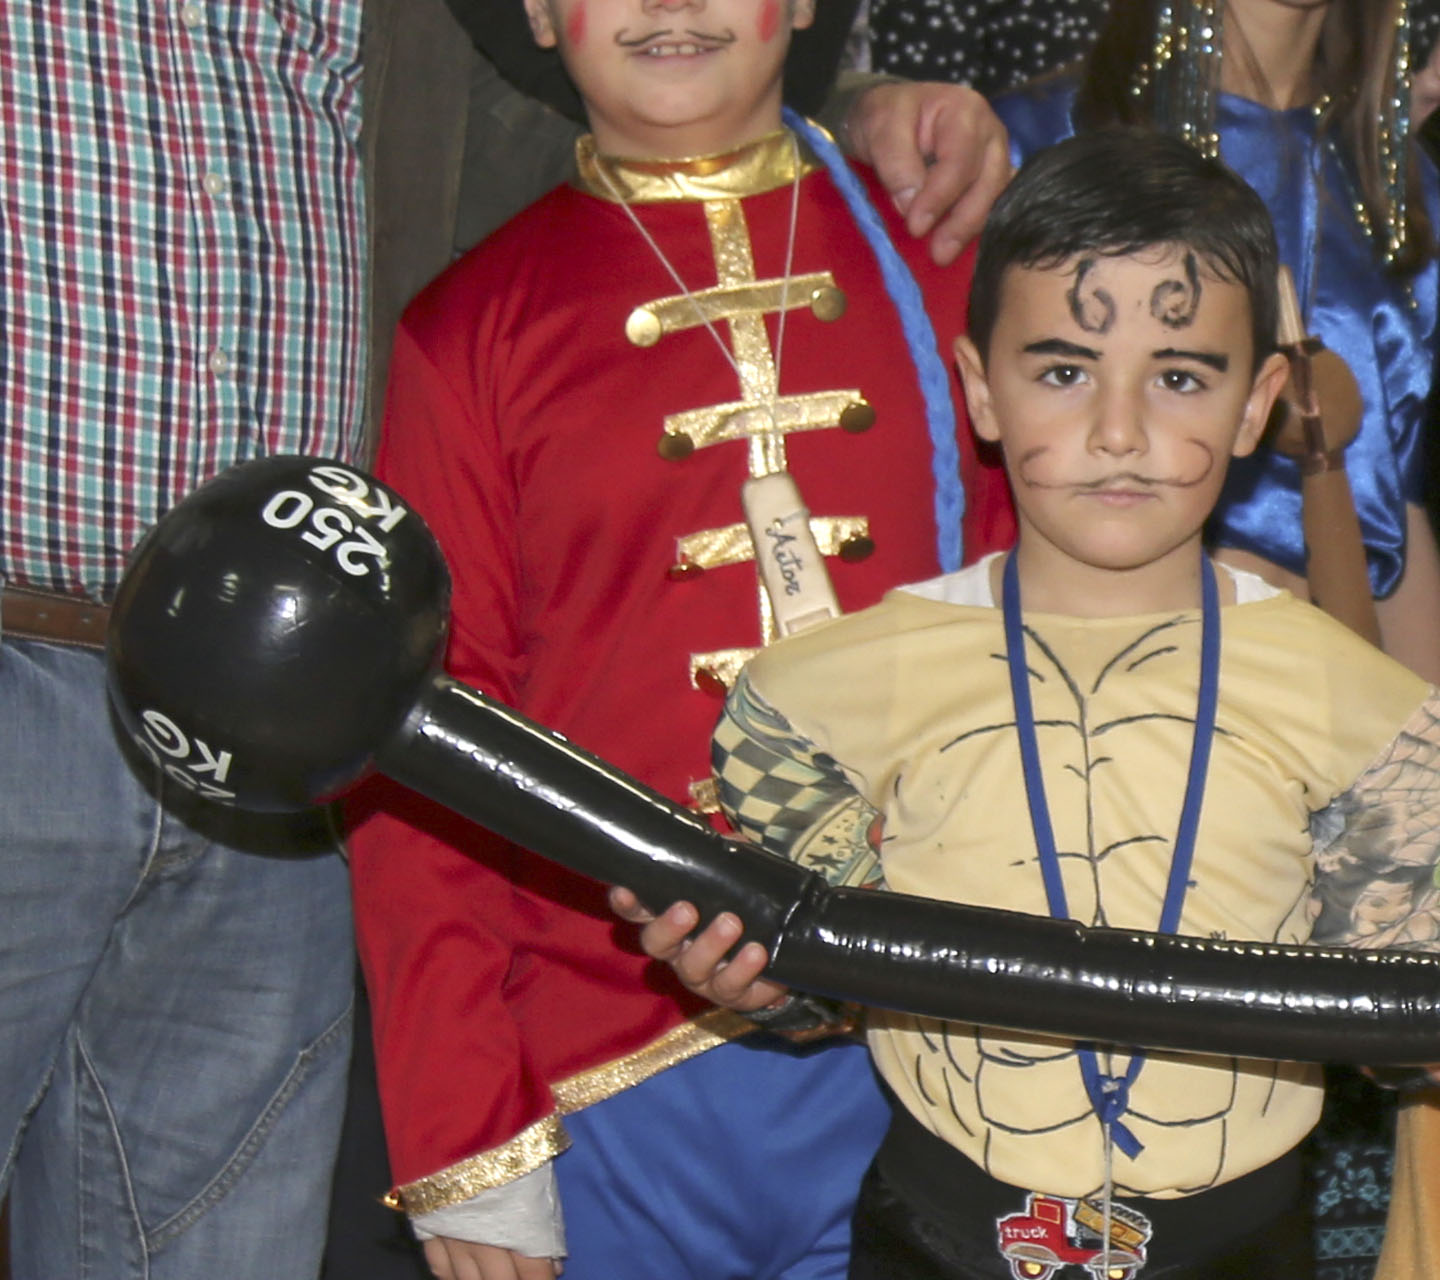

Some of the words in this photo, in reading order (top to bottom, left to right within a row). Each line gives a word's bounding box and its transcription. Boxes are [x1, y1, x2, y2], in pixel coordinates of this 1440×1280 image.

[262, 490, 388, 576] 250
[308, 466, 408, 533] KG
[142, 709, 233, 782] KG
[1004, 1225, 1049, 1239] truck
